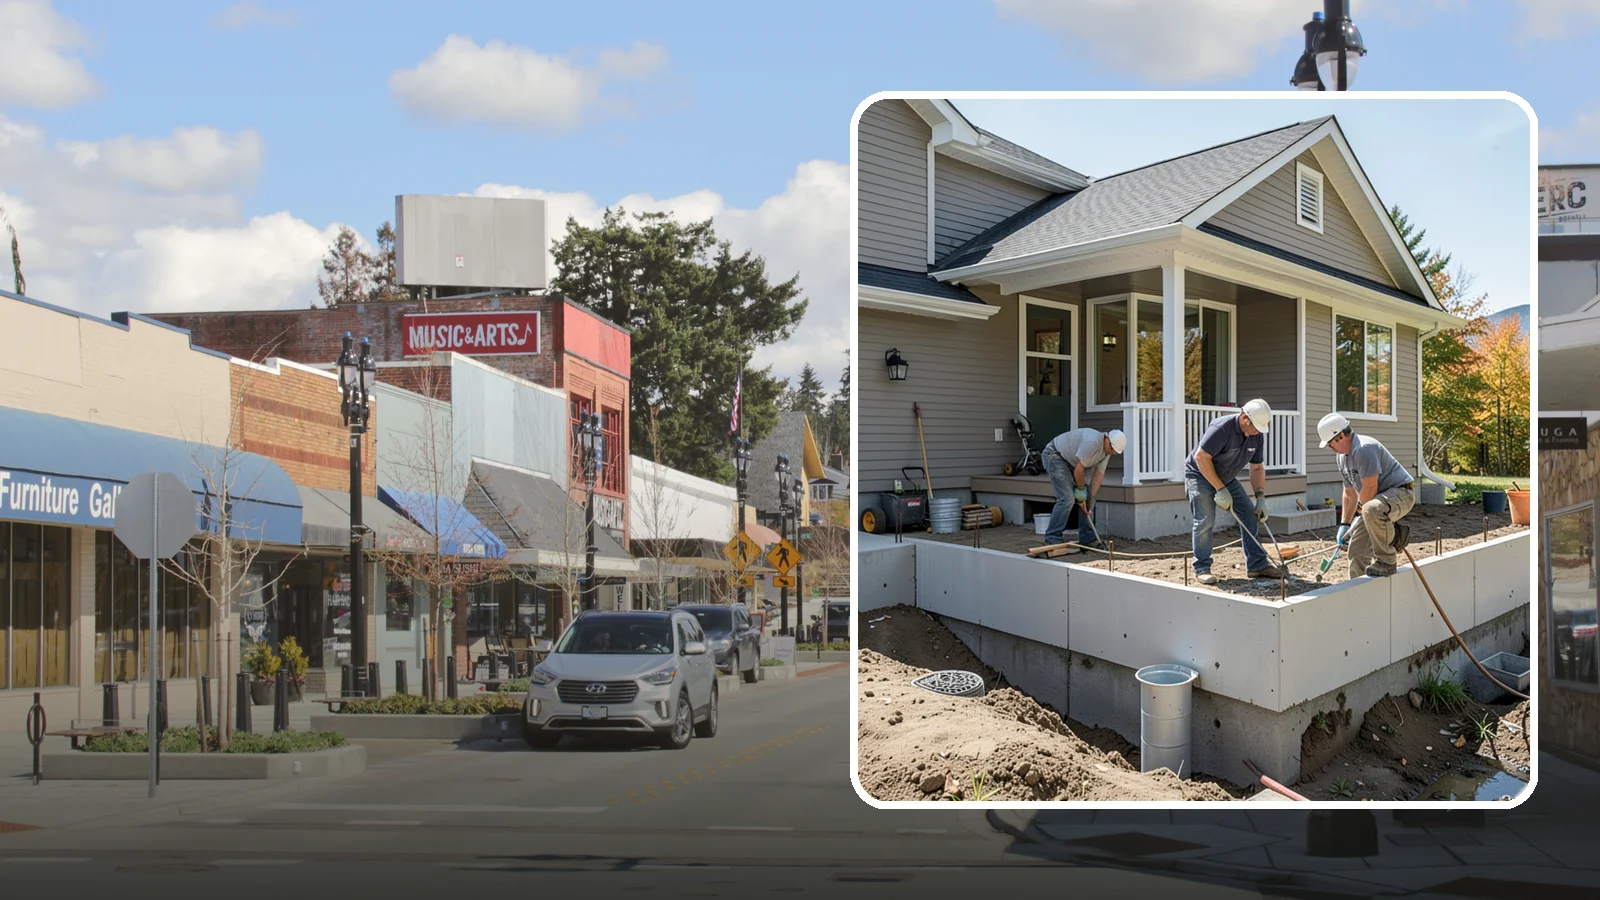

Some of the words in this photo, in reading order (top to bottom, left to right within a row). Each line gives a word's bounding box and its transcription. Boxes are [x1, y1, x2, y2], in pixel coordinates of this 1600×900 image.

[409, 323, 520, 349] MUSIC&ARTS
[0, 471, 79, 515] Furniture
[89, 482, 122, 519] Gal
